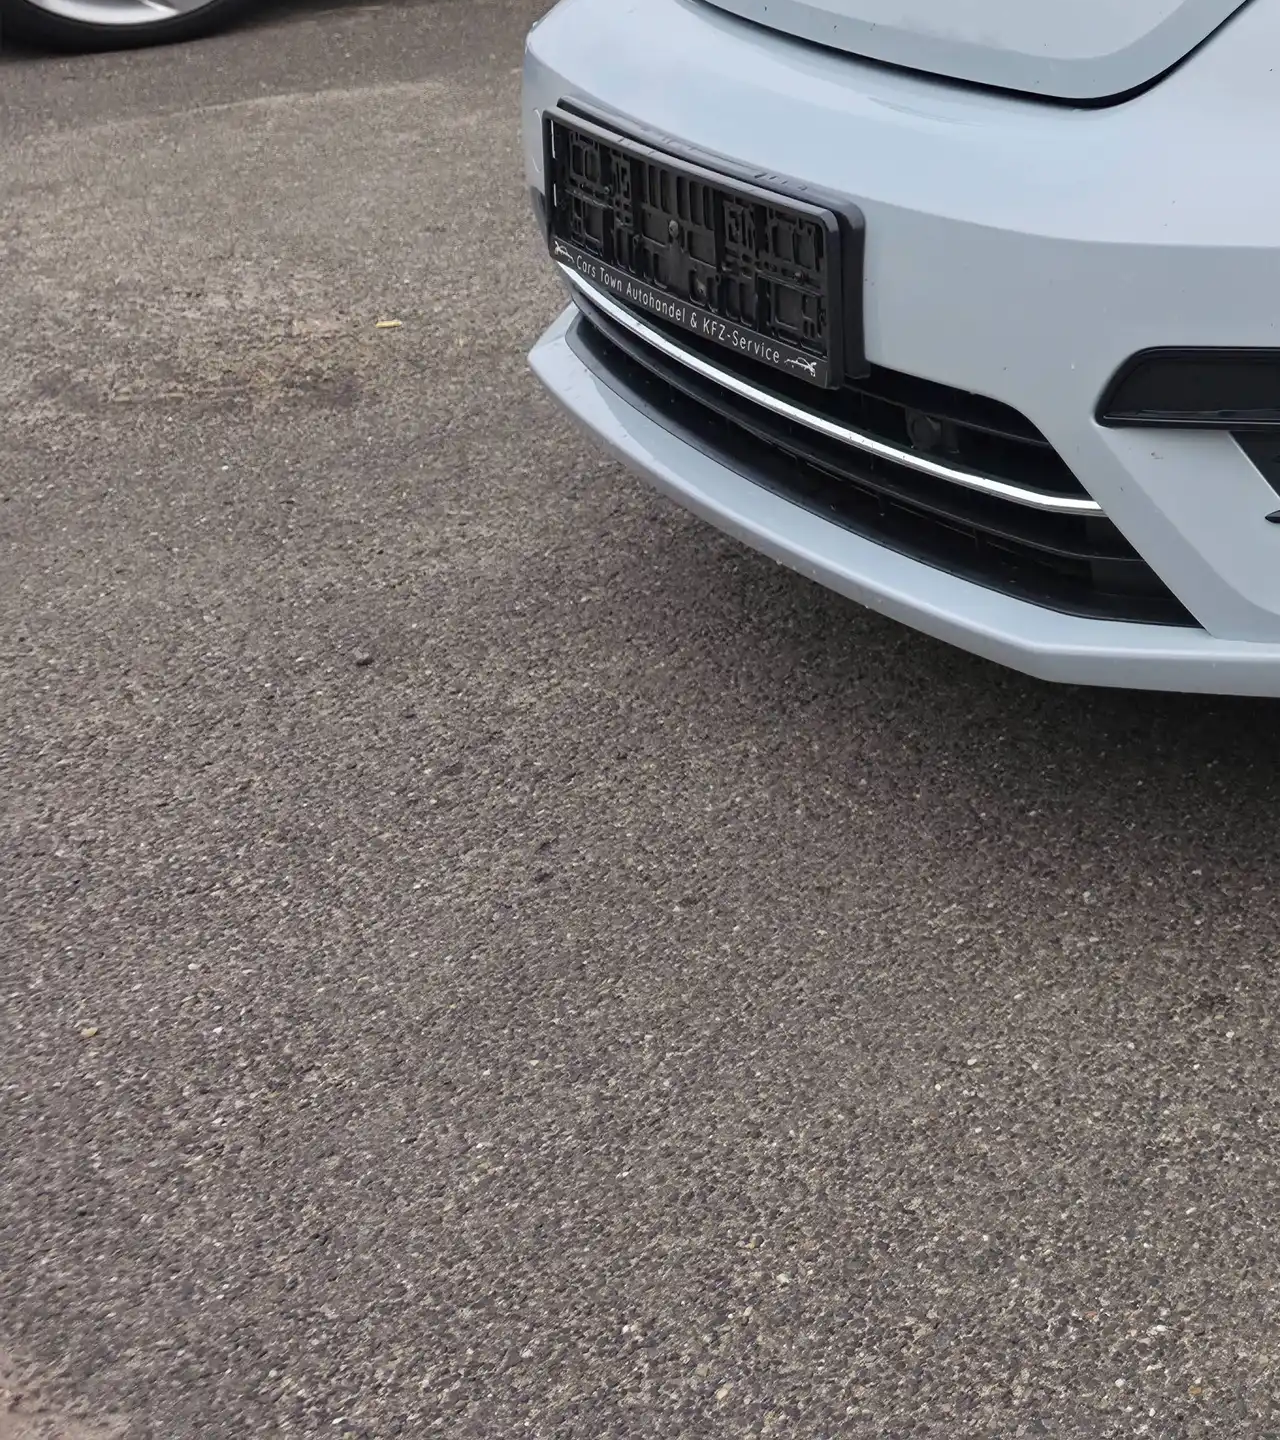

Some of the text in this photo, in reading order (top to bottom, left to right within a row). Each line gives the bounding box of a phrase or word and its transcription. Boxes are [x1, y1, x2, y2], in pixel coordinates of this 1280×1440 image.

[576, 255, 780, 364] Cars Town Autohandel & KFZ-Service
